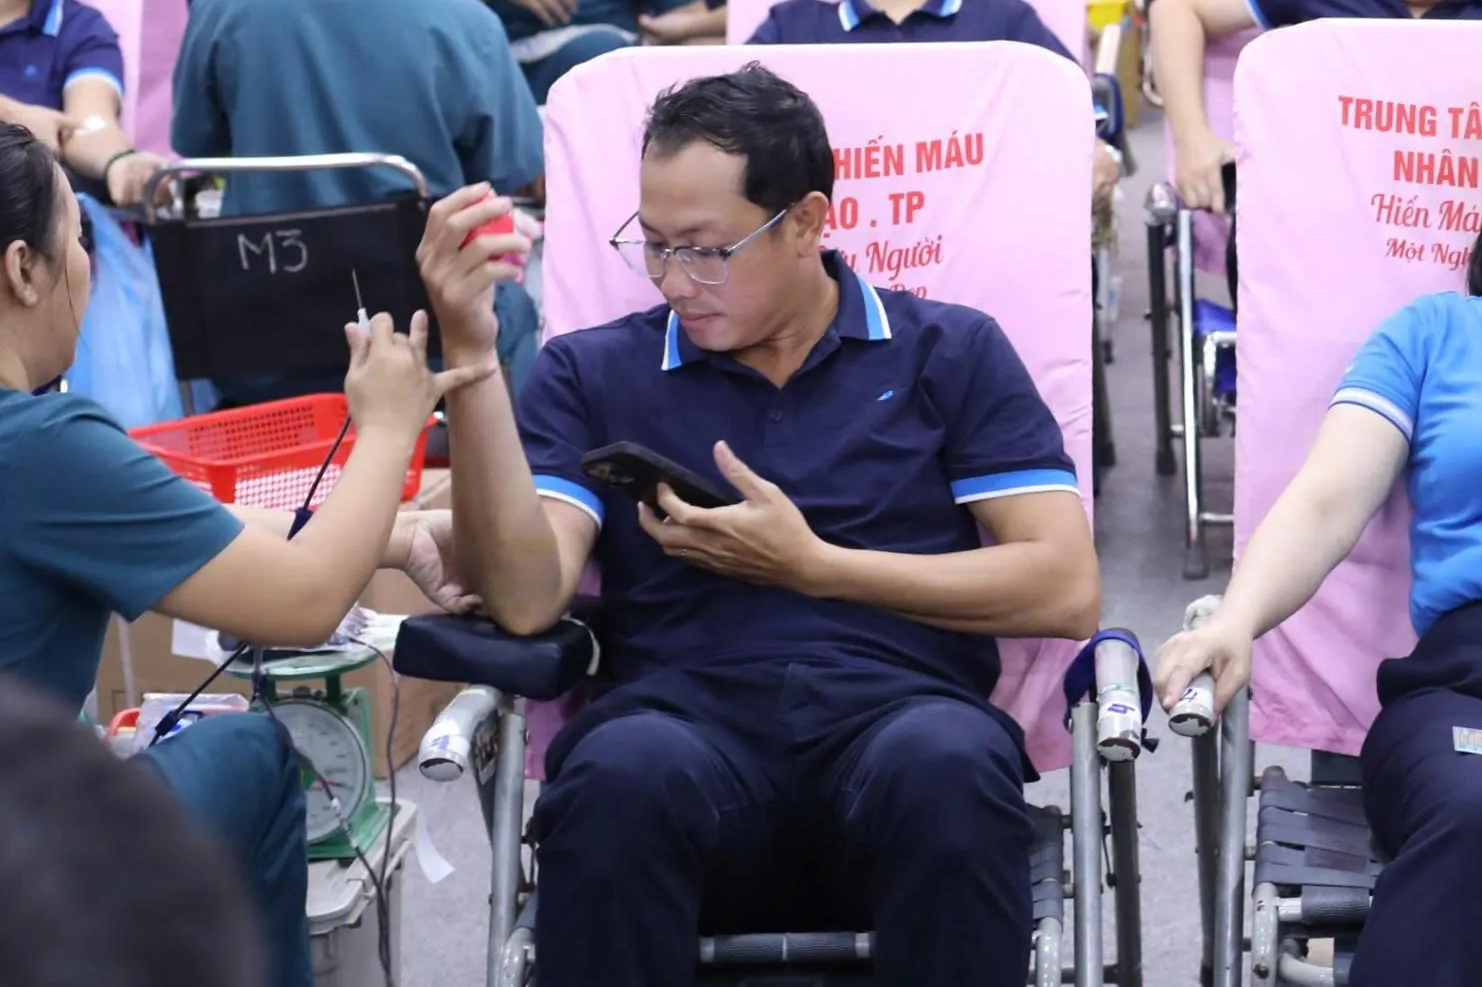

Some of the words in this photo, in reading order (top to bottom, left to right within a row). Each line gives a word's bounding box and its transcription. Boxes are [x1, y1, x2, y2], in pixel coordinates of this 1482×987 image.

[1338, 95, 1437, 137] TRUNG
[833, 135, 904, 180] HIẾN
[916, 130, 984, 174] MÁU
[1393, 148, 1478, 188] NHÂN
[825, 196, 858, 238] ẠO
[888, 190, 925, 225] TP
[1370, 192, 1432, 230] Hiến
[237, 228, 308, 274] M3
[865, 234, 944, 281] Người
[1385, 237, 1425, 263] Một
[1431, 242, 1474, 272] Ngh
